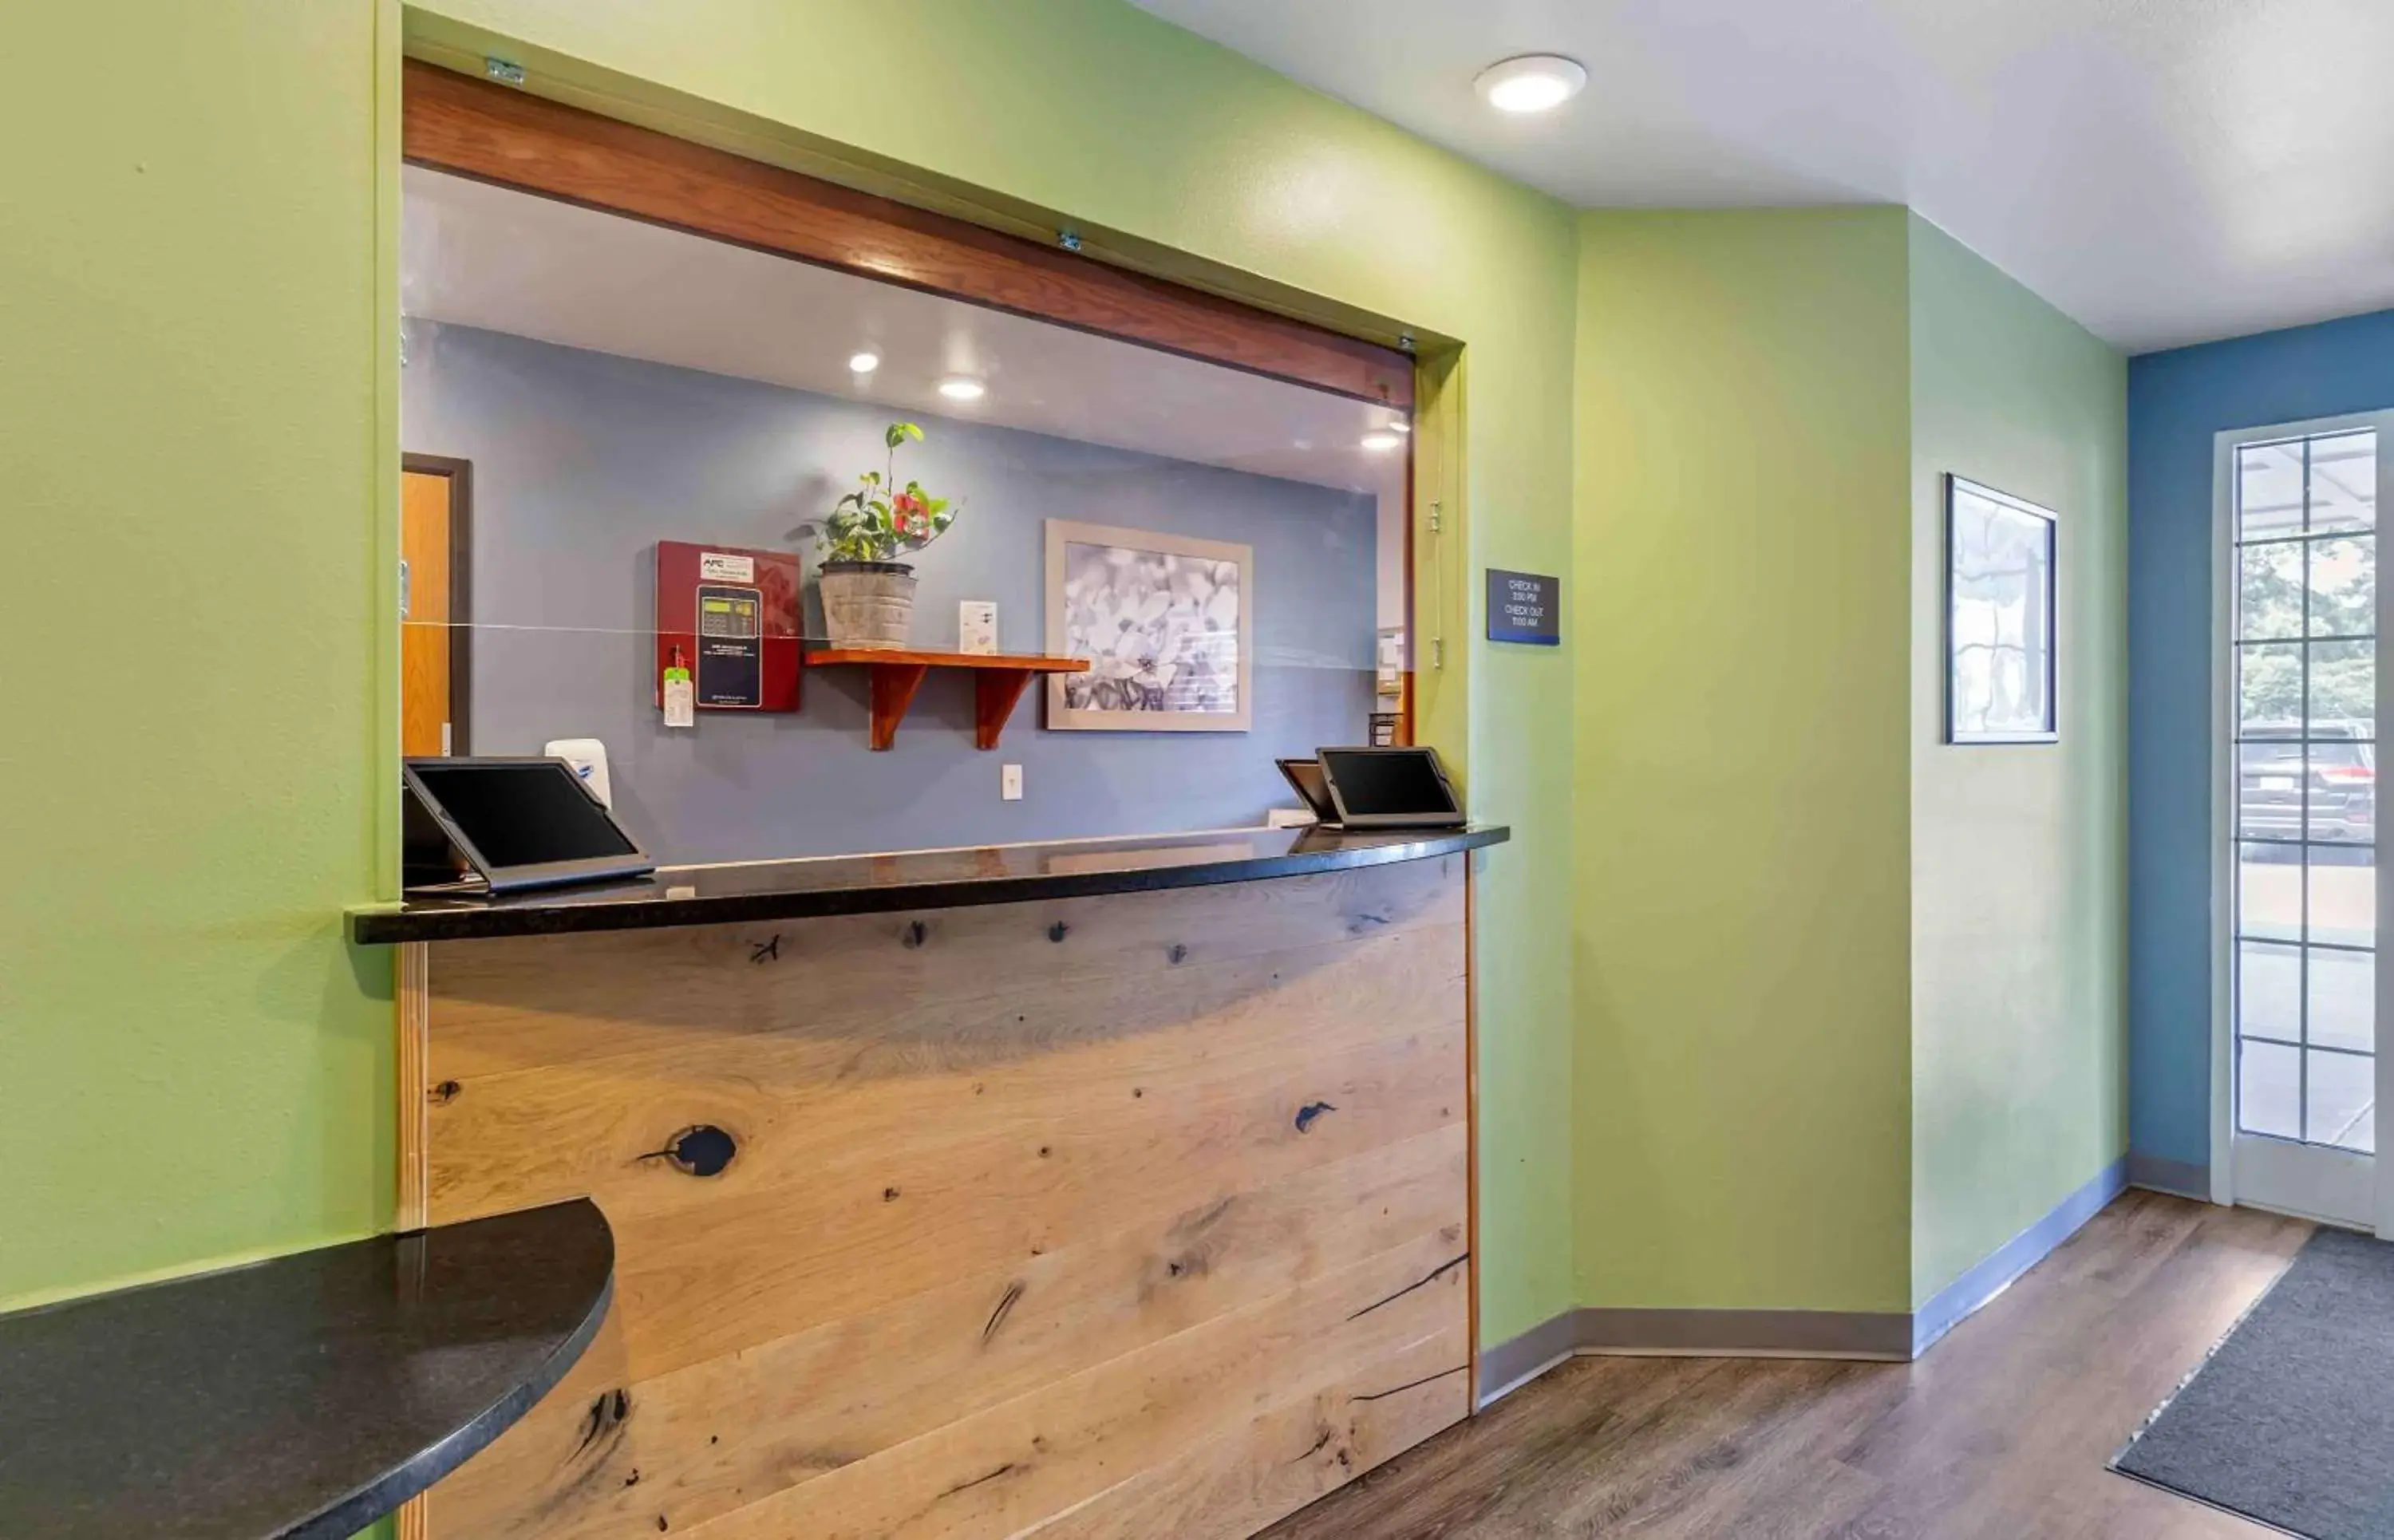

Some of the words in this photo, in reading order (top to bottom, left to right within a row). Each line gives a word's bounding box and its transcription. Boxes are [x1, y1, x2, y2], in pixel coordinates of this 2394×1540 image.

[1508, 579, 1531, 591] CHECK
[1505, 604, 1527, 615] CHECK
[1529, 606, 1544, 617] OUT
[1527, 618, 1539, 627] AM
